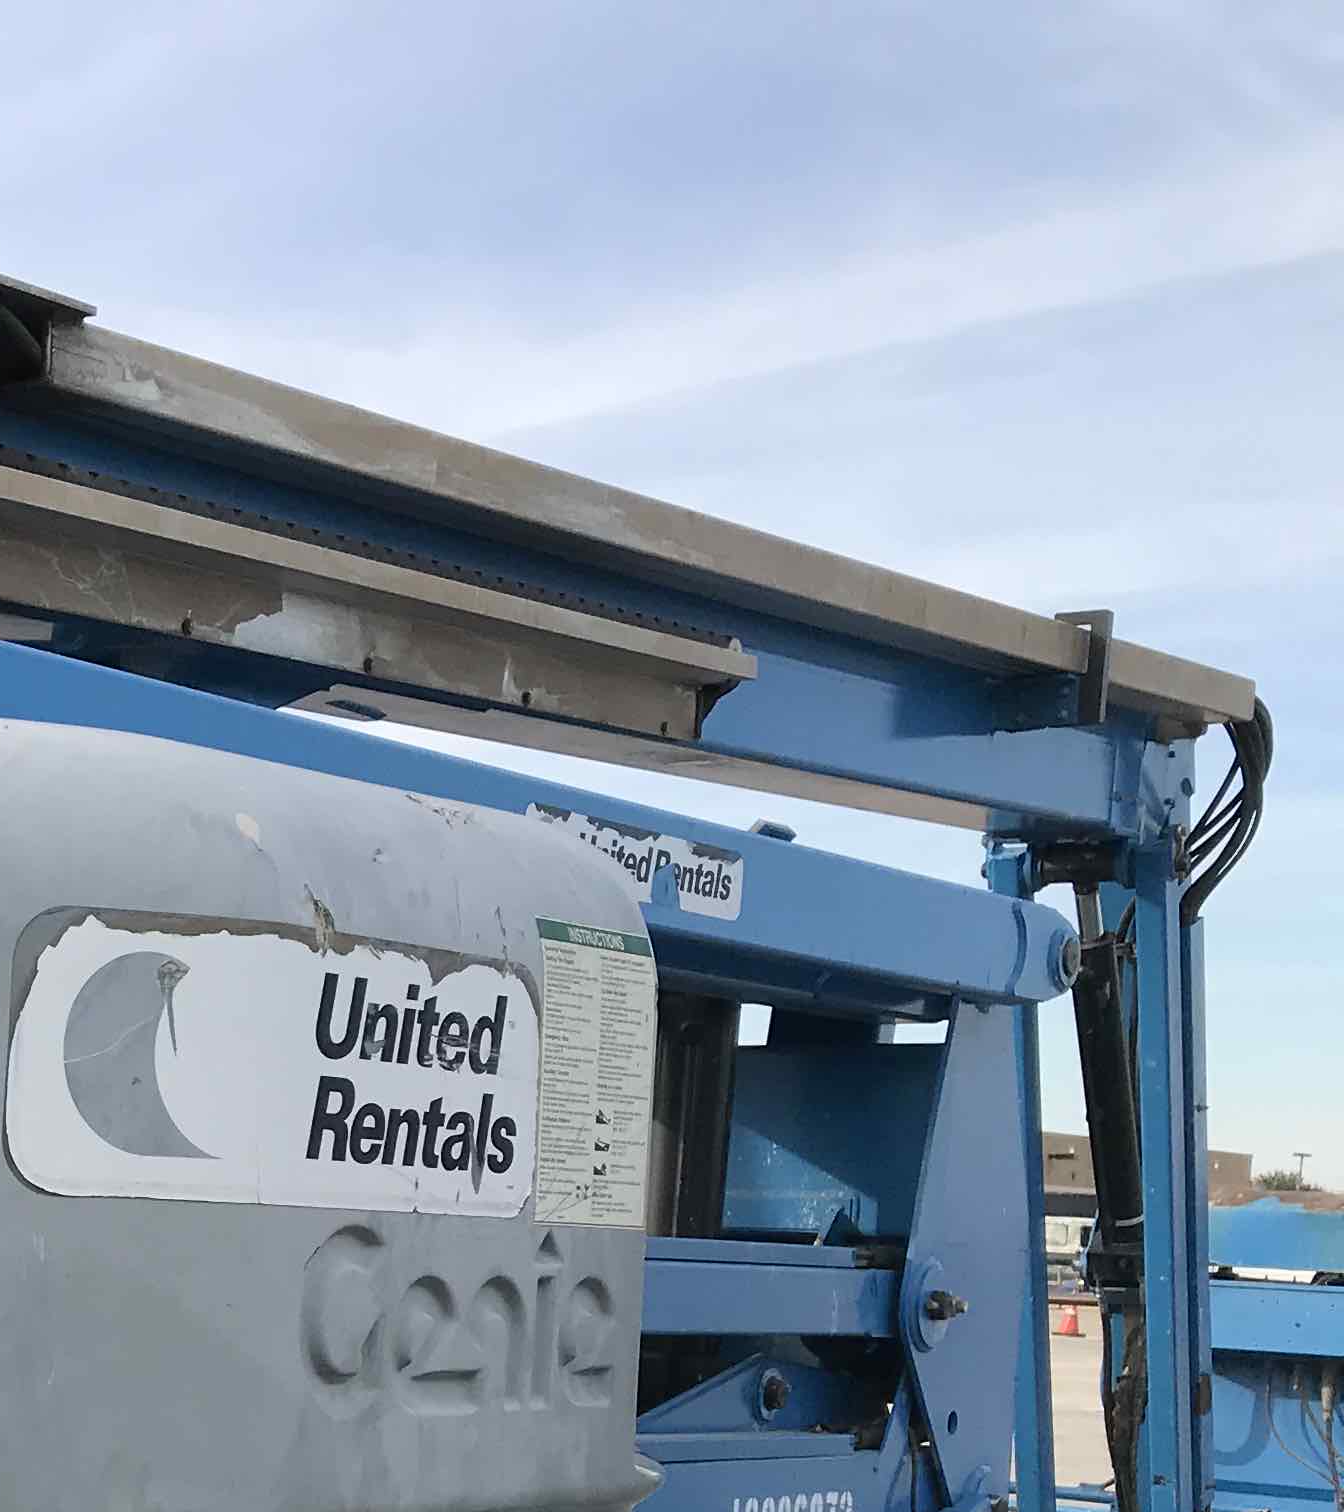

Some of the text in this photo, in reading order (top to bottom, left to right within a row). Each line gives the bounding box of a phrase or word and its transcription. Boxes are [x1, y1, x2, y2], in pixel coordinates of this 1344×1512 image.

[568, 926, 624, 952] INSTRUCTIONS
[315, 972, 508, 1076] United
[306, 1075, 517, 1175] Rentals
